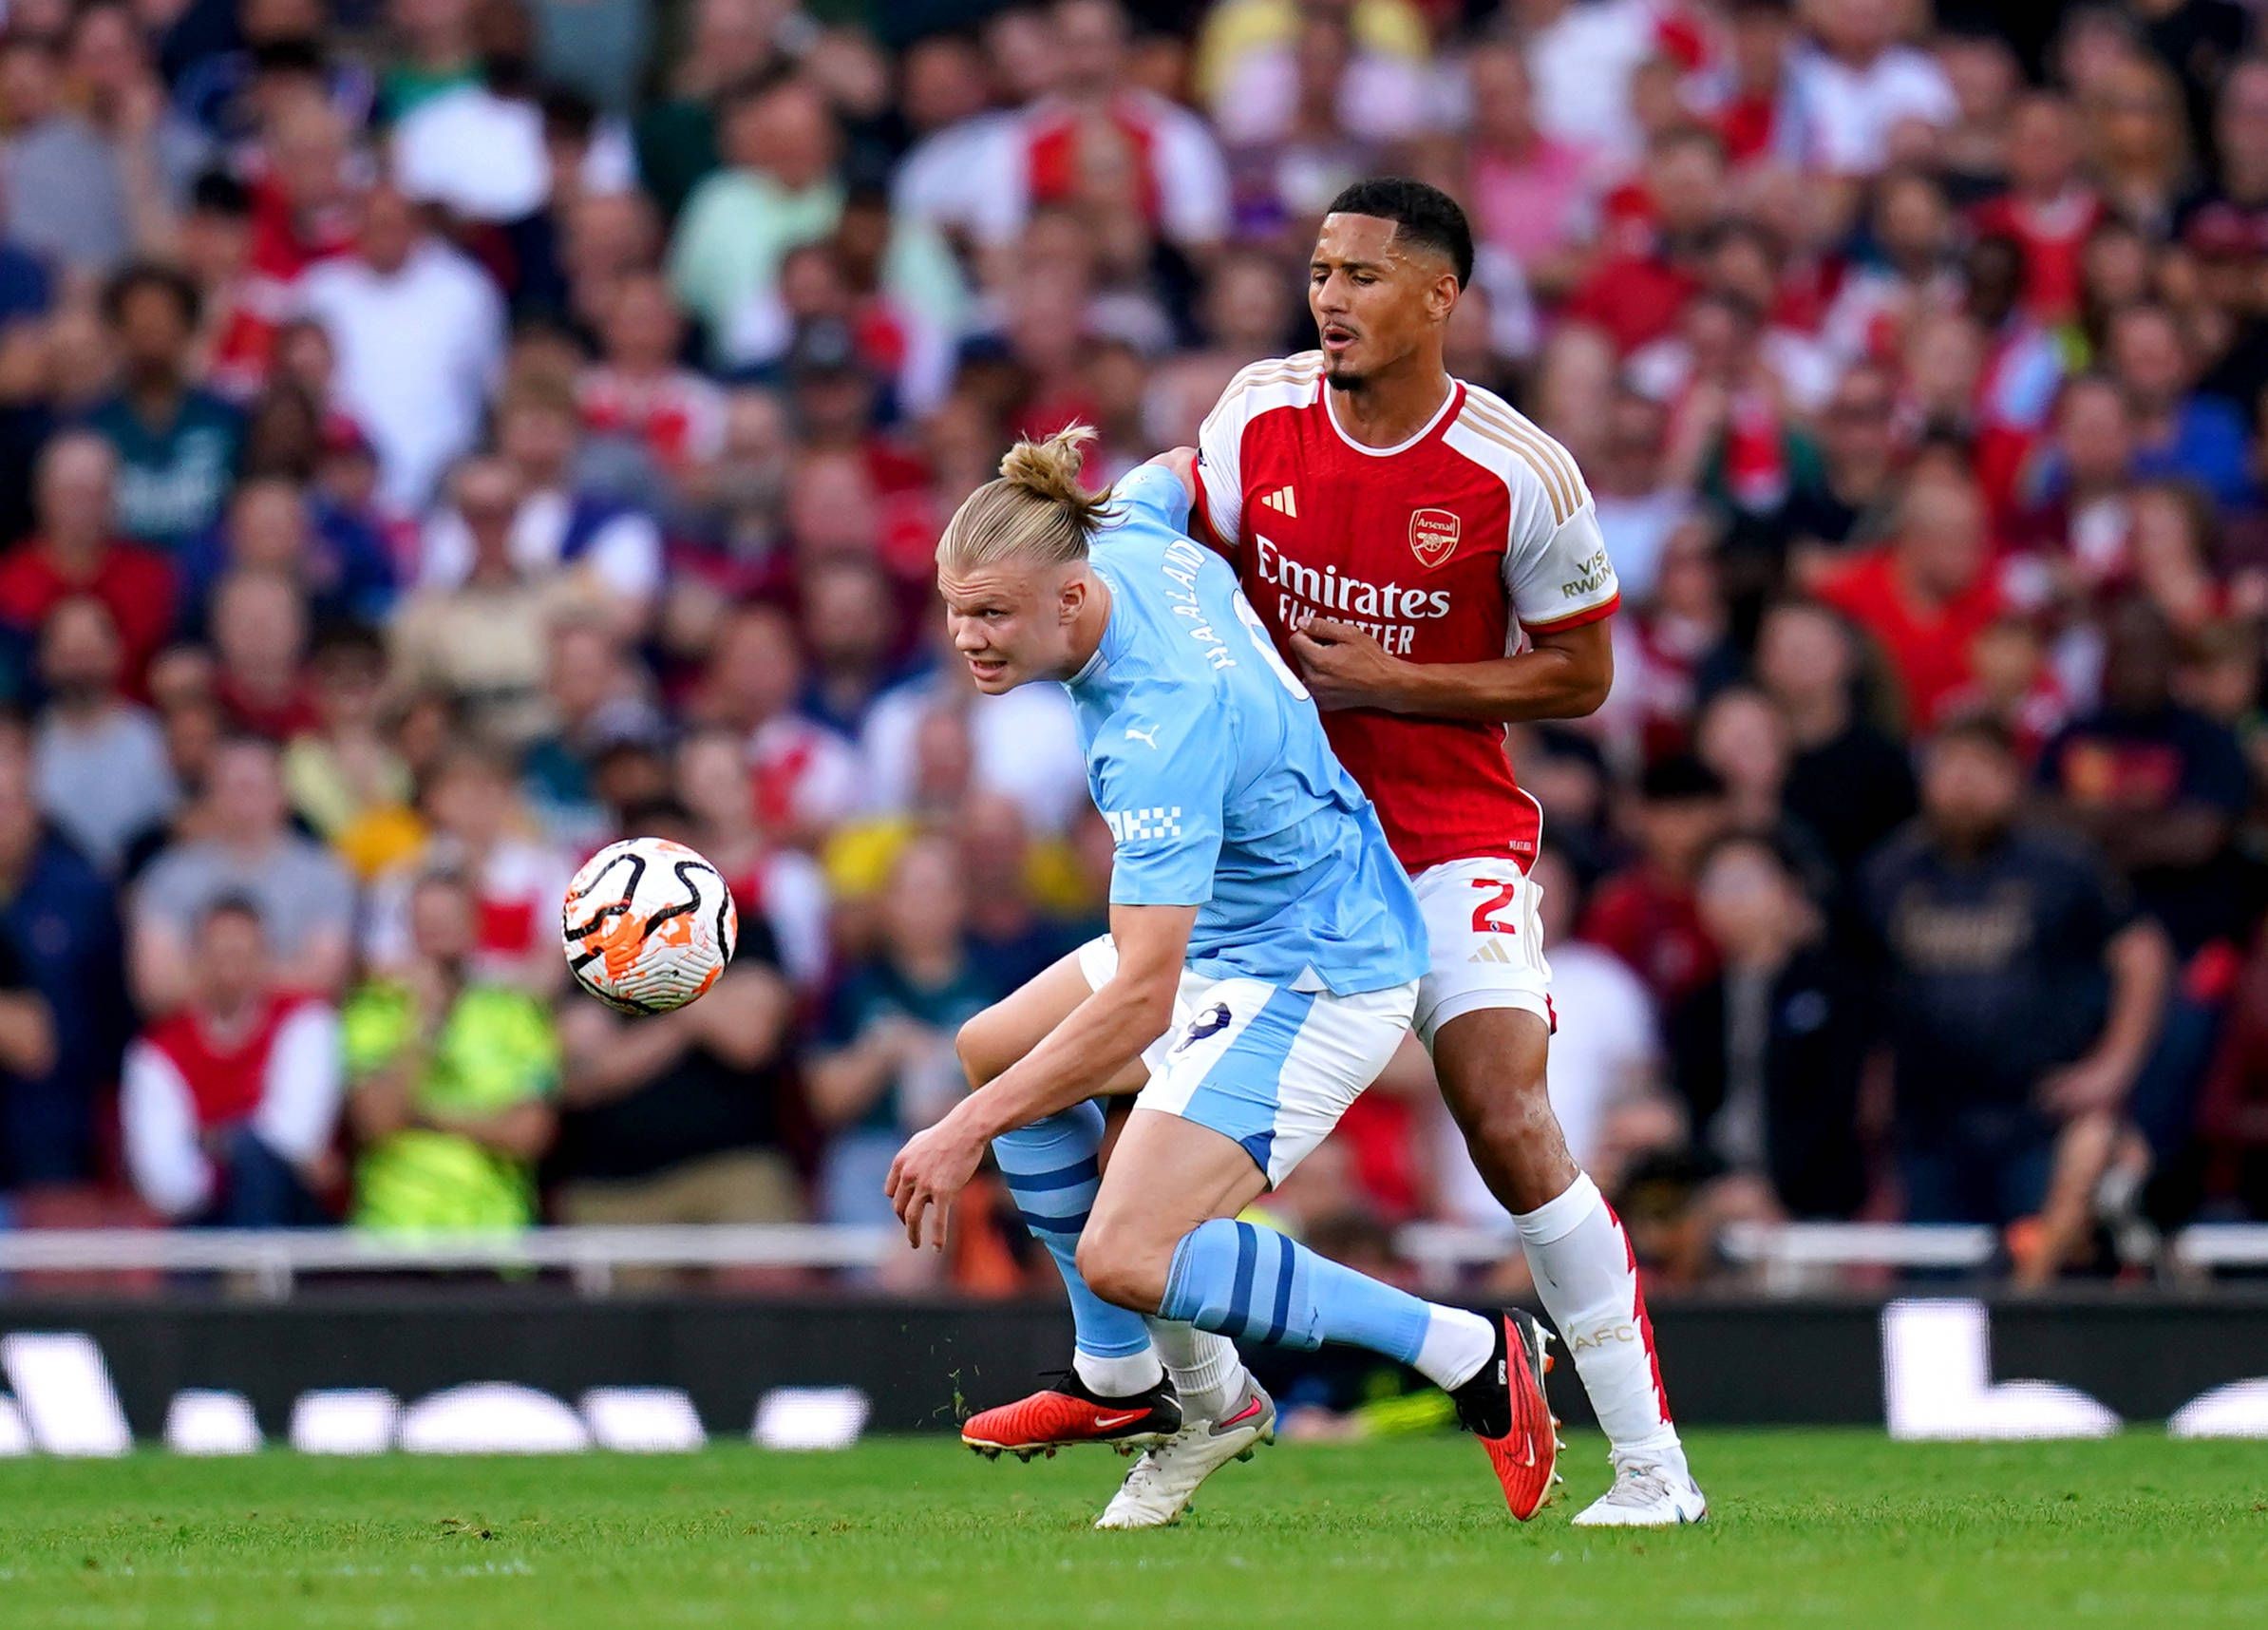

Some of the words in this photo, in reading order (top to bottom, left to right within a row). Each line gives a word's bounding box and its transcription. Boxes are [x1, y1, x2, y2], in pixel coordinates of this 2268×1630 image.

[1417, 518, 1454, 532] Arsenal
[1256, 533, 1450, 618] Emirates
[1162, 539, 1238, 671] HAALAND
[1471, 879, 1516, 935] 2
[1575, 1324, 1635, 1353] AFC
